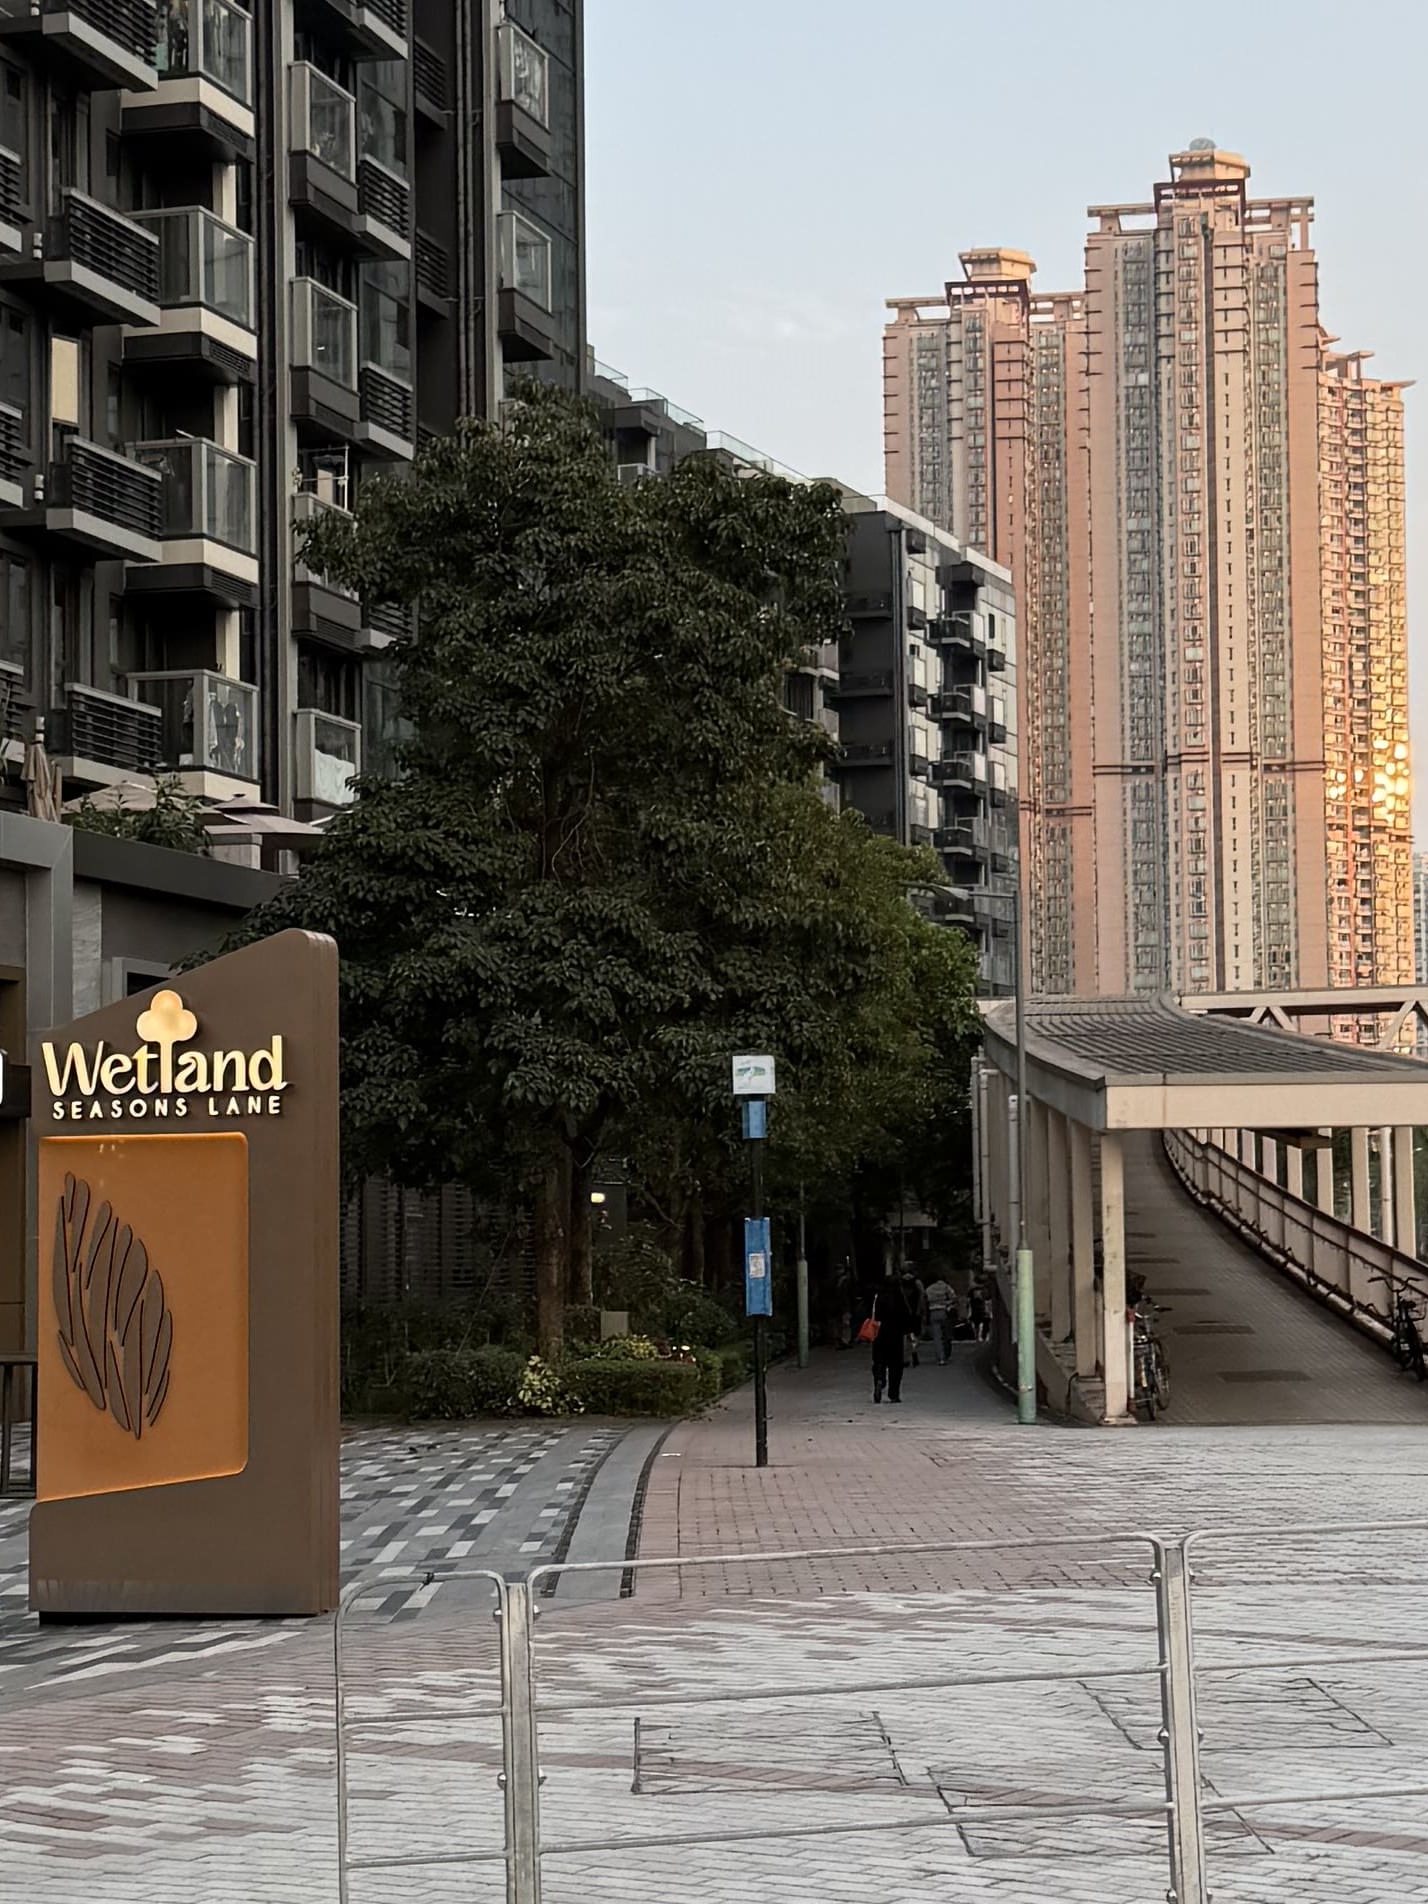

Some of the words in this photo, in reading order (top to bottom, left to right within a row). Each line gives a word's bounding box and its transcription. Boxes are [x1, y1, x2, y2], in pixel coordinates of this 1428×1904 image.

[42, 1034, 289, 1096] Wetland
[52, 1098, 188, 1120] SEASONS
[209, 1096, 281, 1116] LANE
